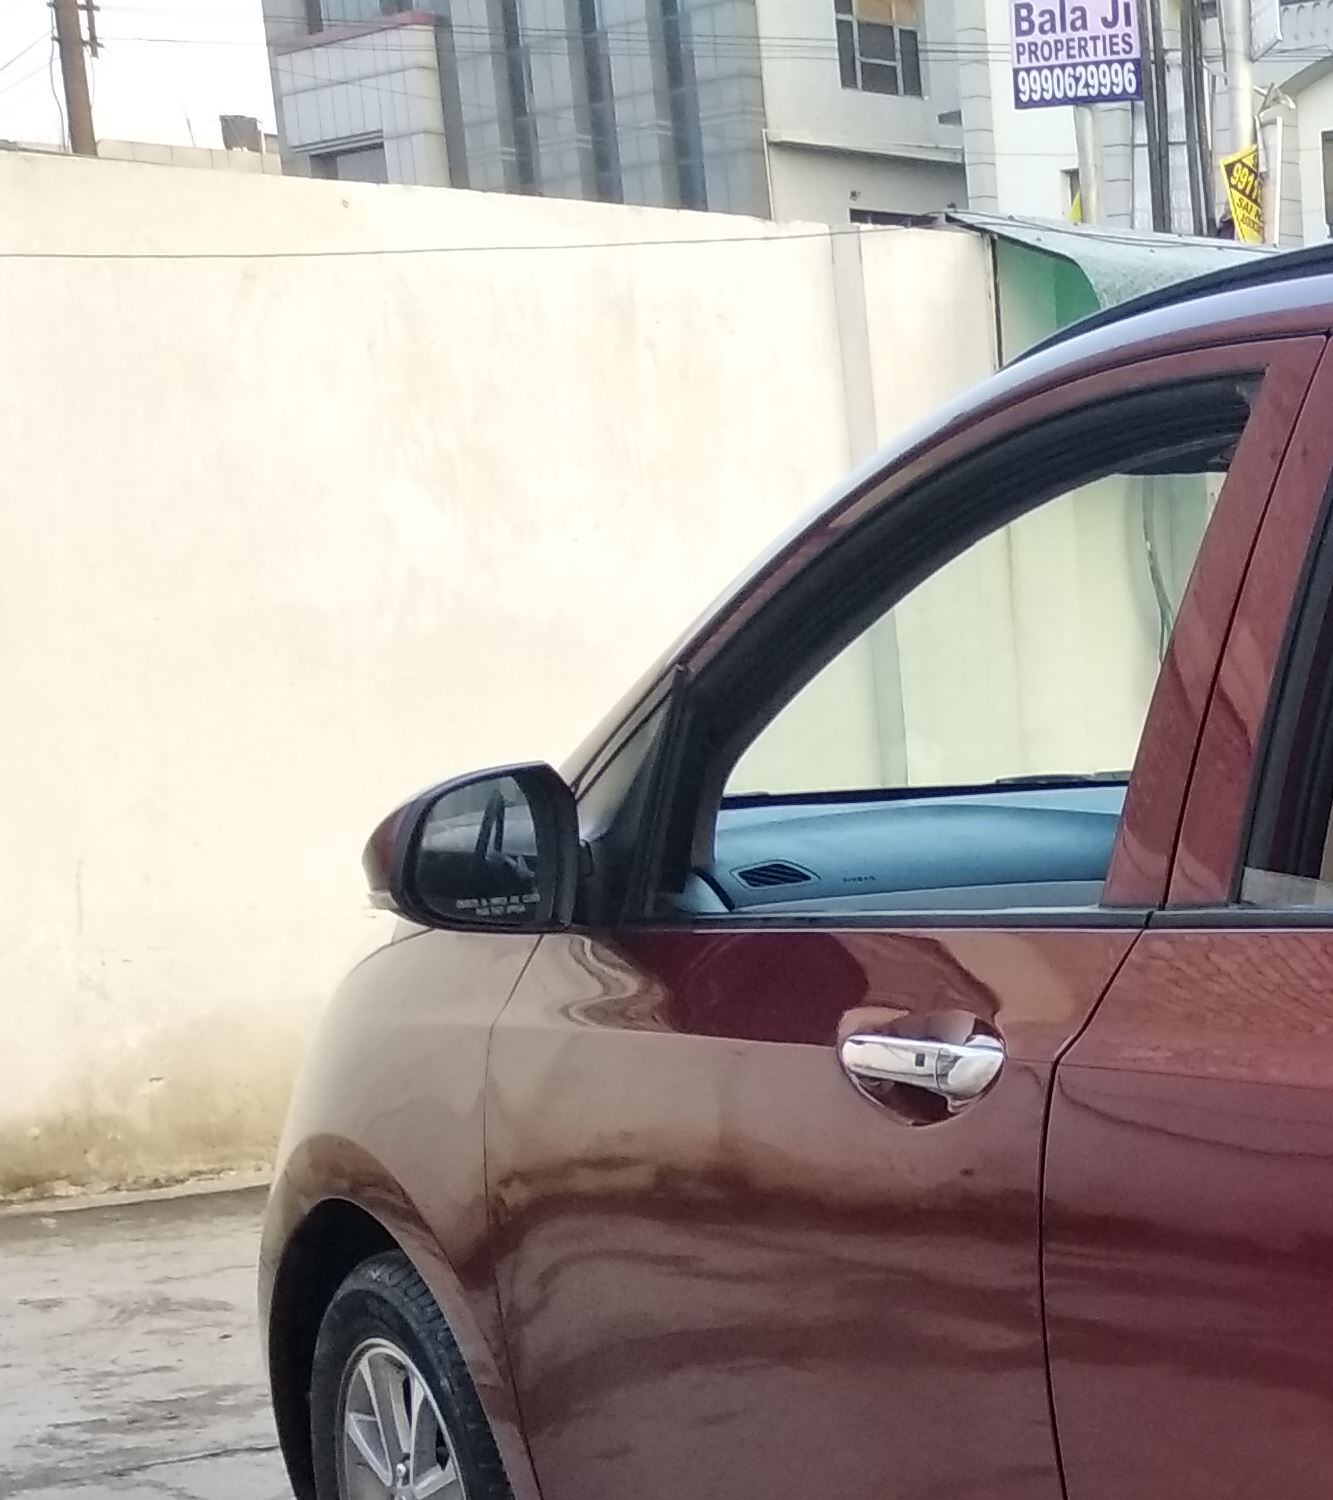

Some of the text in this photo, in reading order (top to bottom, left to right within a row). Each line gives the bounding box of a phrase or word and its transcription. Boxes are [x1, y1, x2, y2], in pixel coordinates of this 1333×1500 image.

[1014, 0, 1132, 37] Bala Ji
[1016, 33, 1134, 64] PROPERTIES
[1018, 62, 1137, 103] 9990629996
